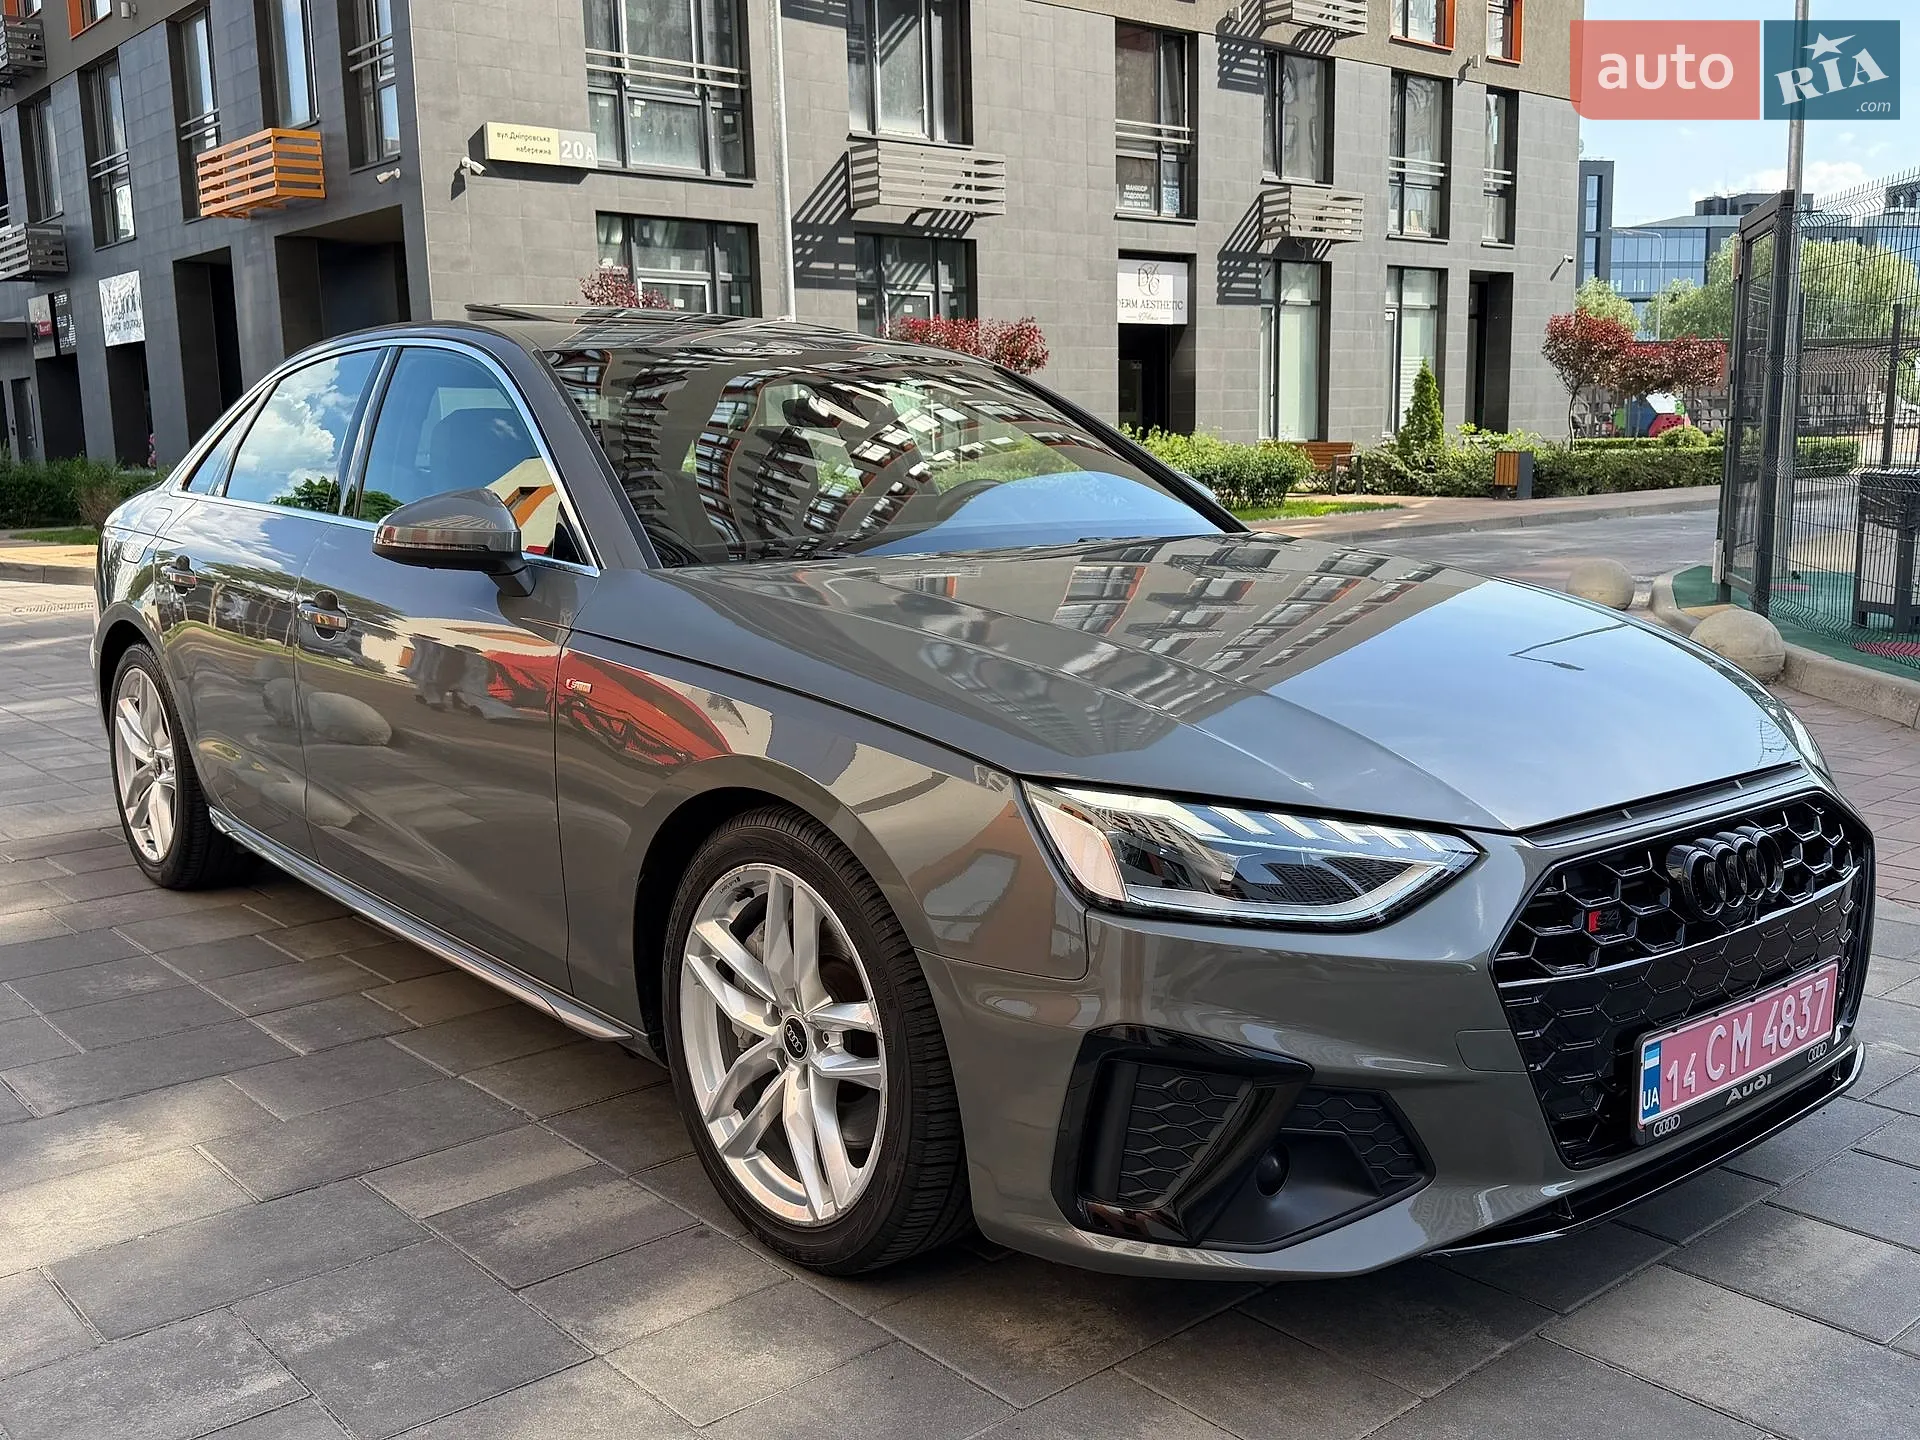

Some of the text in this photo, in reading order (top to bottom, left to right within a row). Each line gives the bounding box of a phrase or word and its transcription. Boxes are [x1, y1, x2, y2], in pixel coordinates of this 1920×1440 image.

[1140, 299, 1184, 311] AESTHETIC
[1666, 977, 1829, 1101] 14 CM 4837
[1643, 1086, 1660, 1110] UA
[1725, 1073, 1772, 1107] Audi
